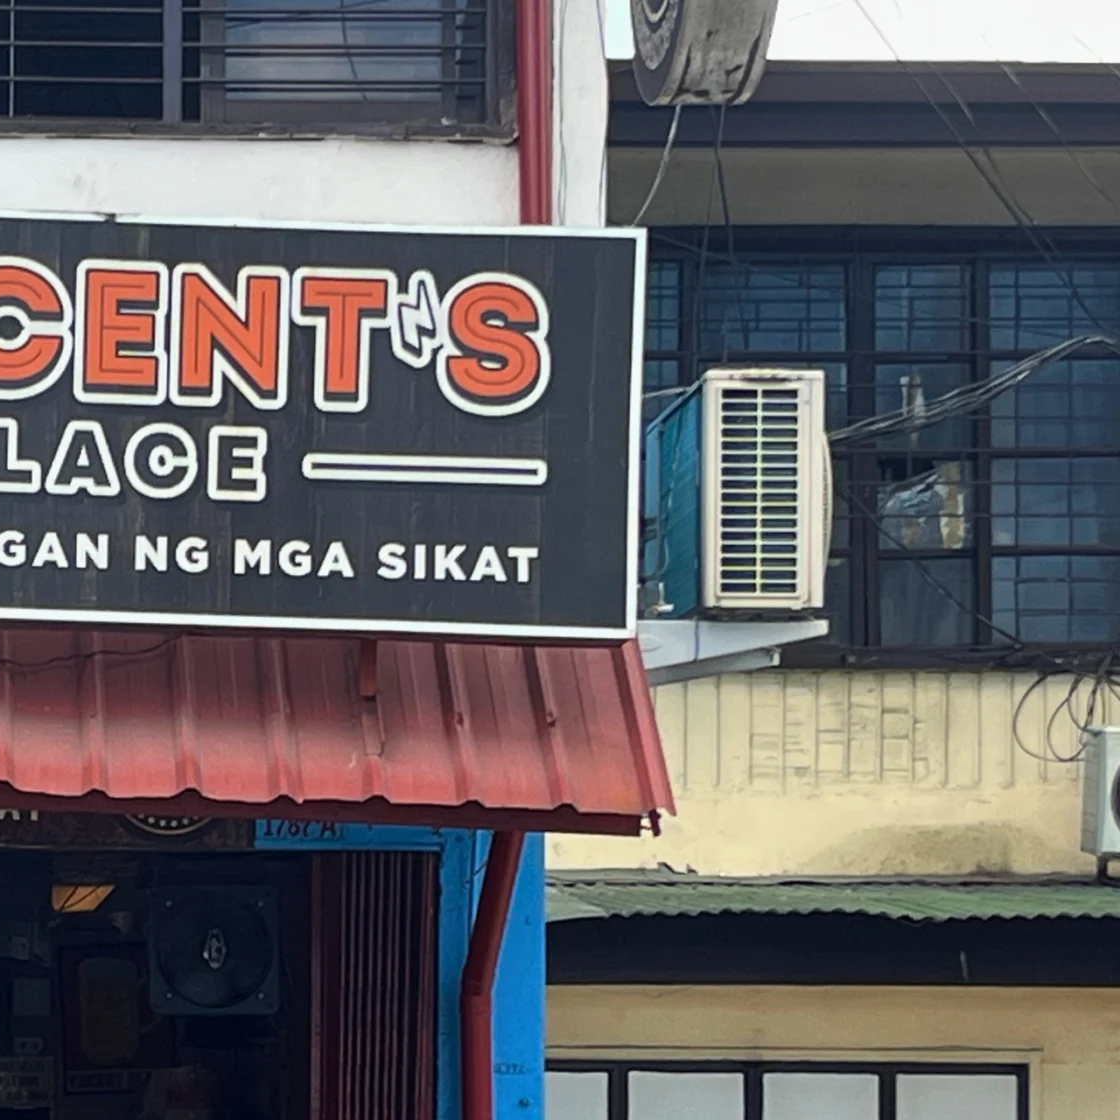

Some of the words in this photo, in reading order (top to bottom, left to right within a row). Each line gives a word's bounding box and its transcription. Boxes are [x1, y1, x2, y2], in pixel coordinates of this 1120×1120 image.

[135, 536, 208, 573] NG
[235, 539, 353, 577] MGA
[378, 544, 538, 582] SIKAT
